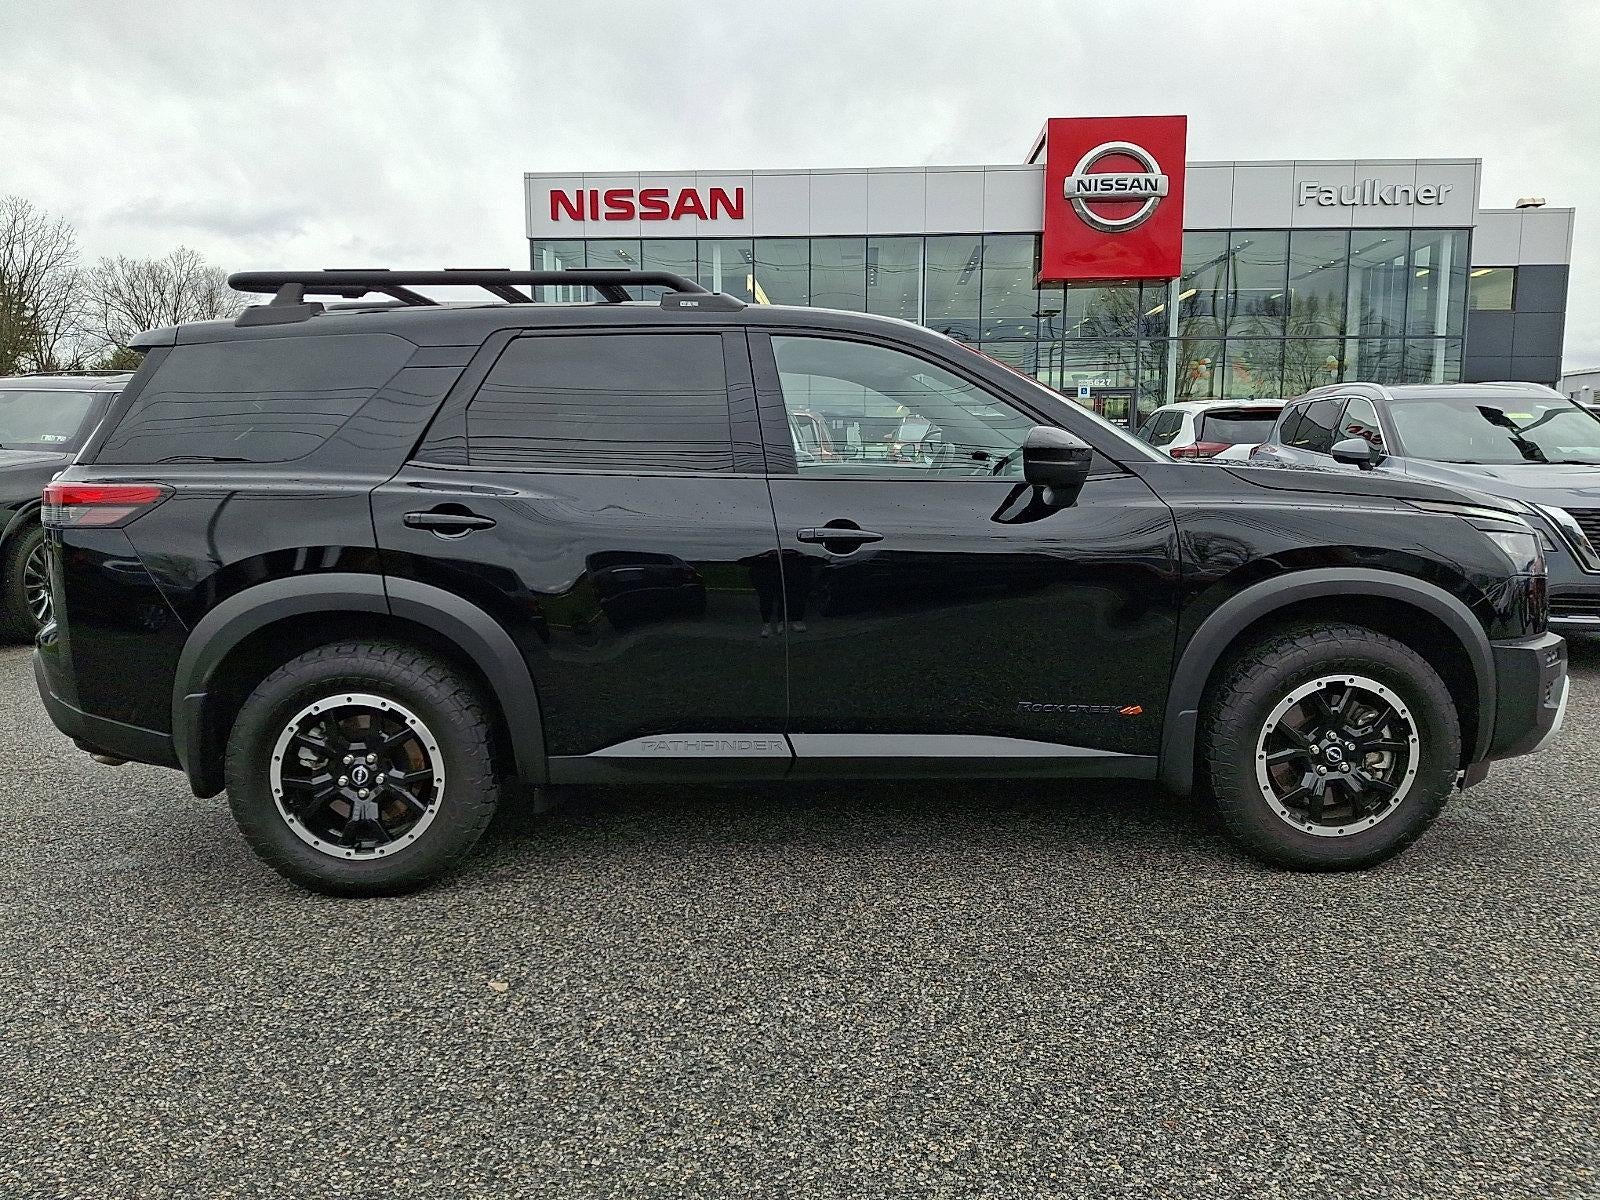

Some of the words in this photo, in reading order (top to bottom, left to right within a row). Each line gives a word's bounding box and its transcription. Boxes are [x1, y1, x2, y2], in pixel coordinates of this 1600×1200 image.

[1076, 178, 1158, 192] NISSAN
[1298, 179, 1453, 207] Faulkner
[550, 188, 744, 221] NISSAN
[1018, 701, 1065, 713] ROCK
[1067, 704, 1121, 713] CREEK
[641, 740, 784, 751] PATHFINDER
